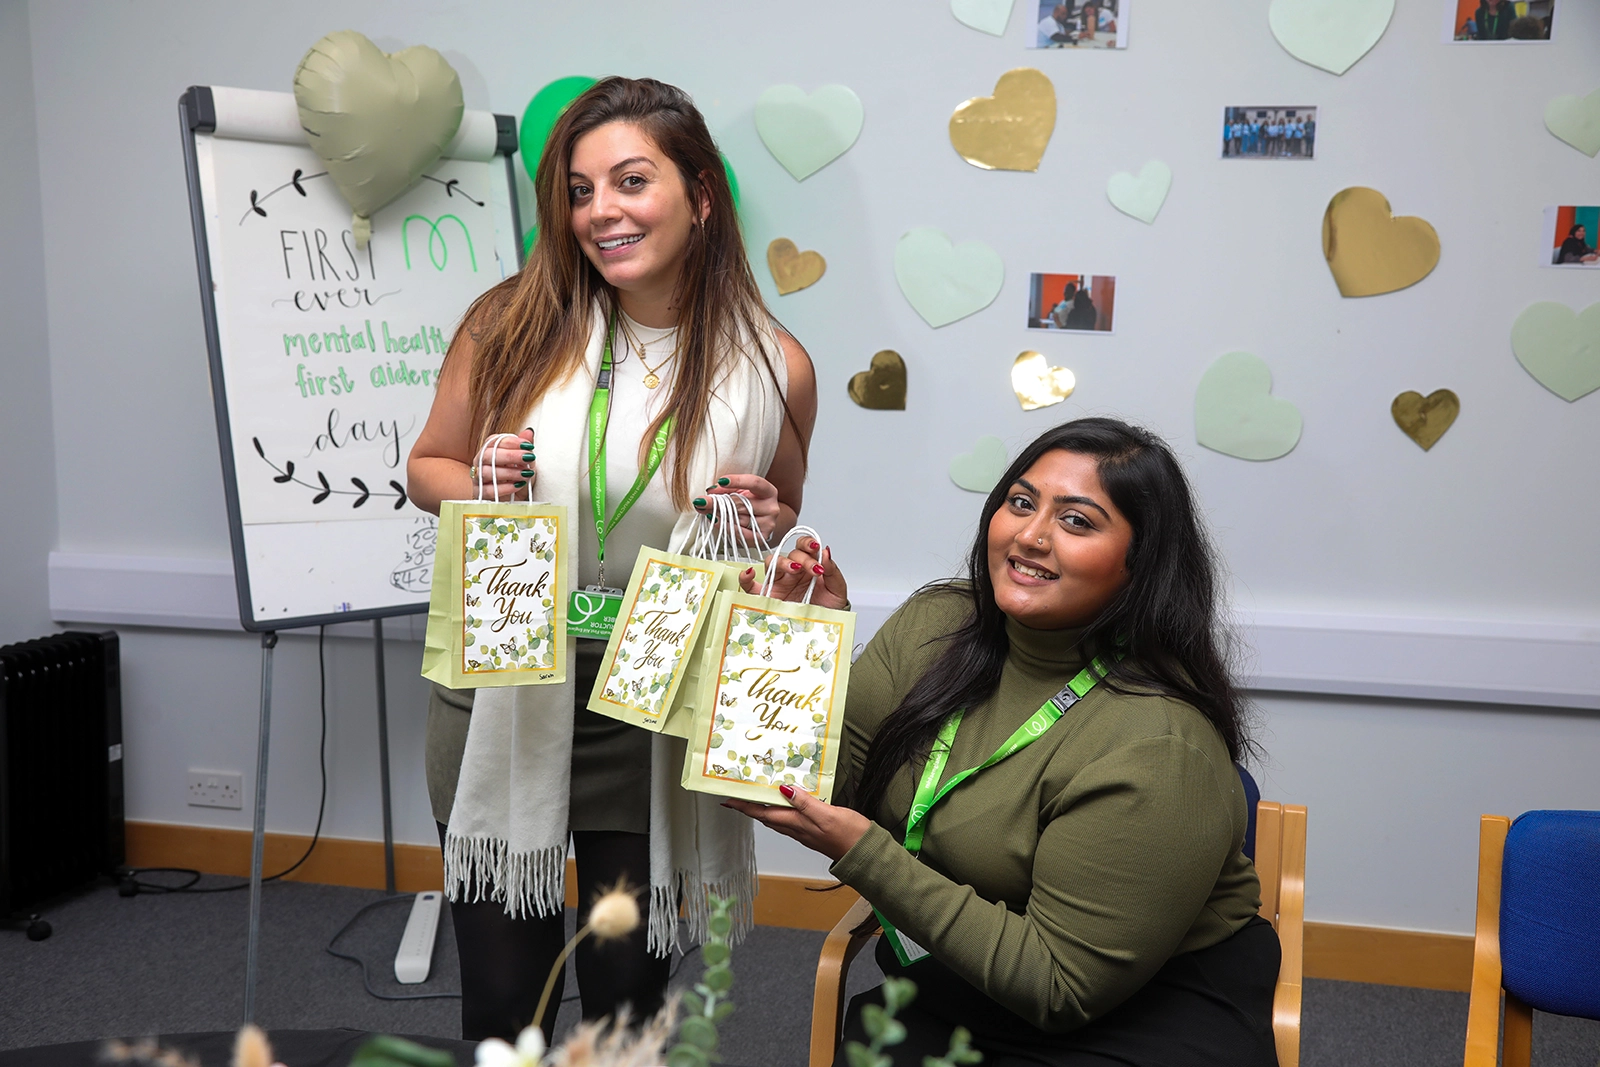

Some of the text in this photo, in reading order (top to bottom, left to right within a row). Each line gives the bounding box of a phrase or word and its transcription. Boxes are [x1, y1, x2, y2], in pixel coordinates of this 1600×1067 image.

[280, 228, 376, 282] FIRST
[271, 287, 402, 312] ever
[283, 319, 450, 357] mental health
[295, 363, 355, 398] first
[303, 408, 416, 469] day
[594, 475, 602, 499] England
[478, 558, 550, 598] Thank
[491, 596, 533, 633] You
[643, 608, 691, 647] Thank
[633, 639, 664, 670] You
[739, 666, 825, 712] Thank
[745, 703, 798, 741] You
